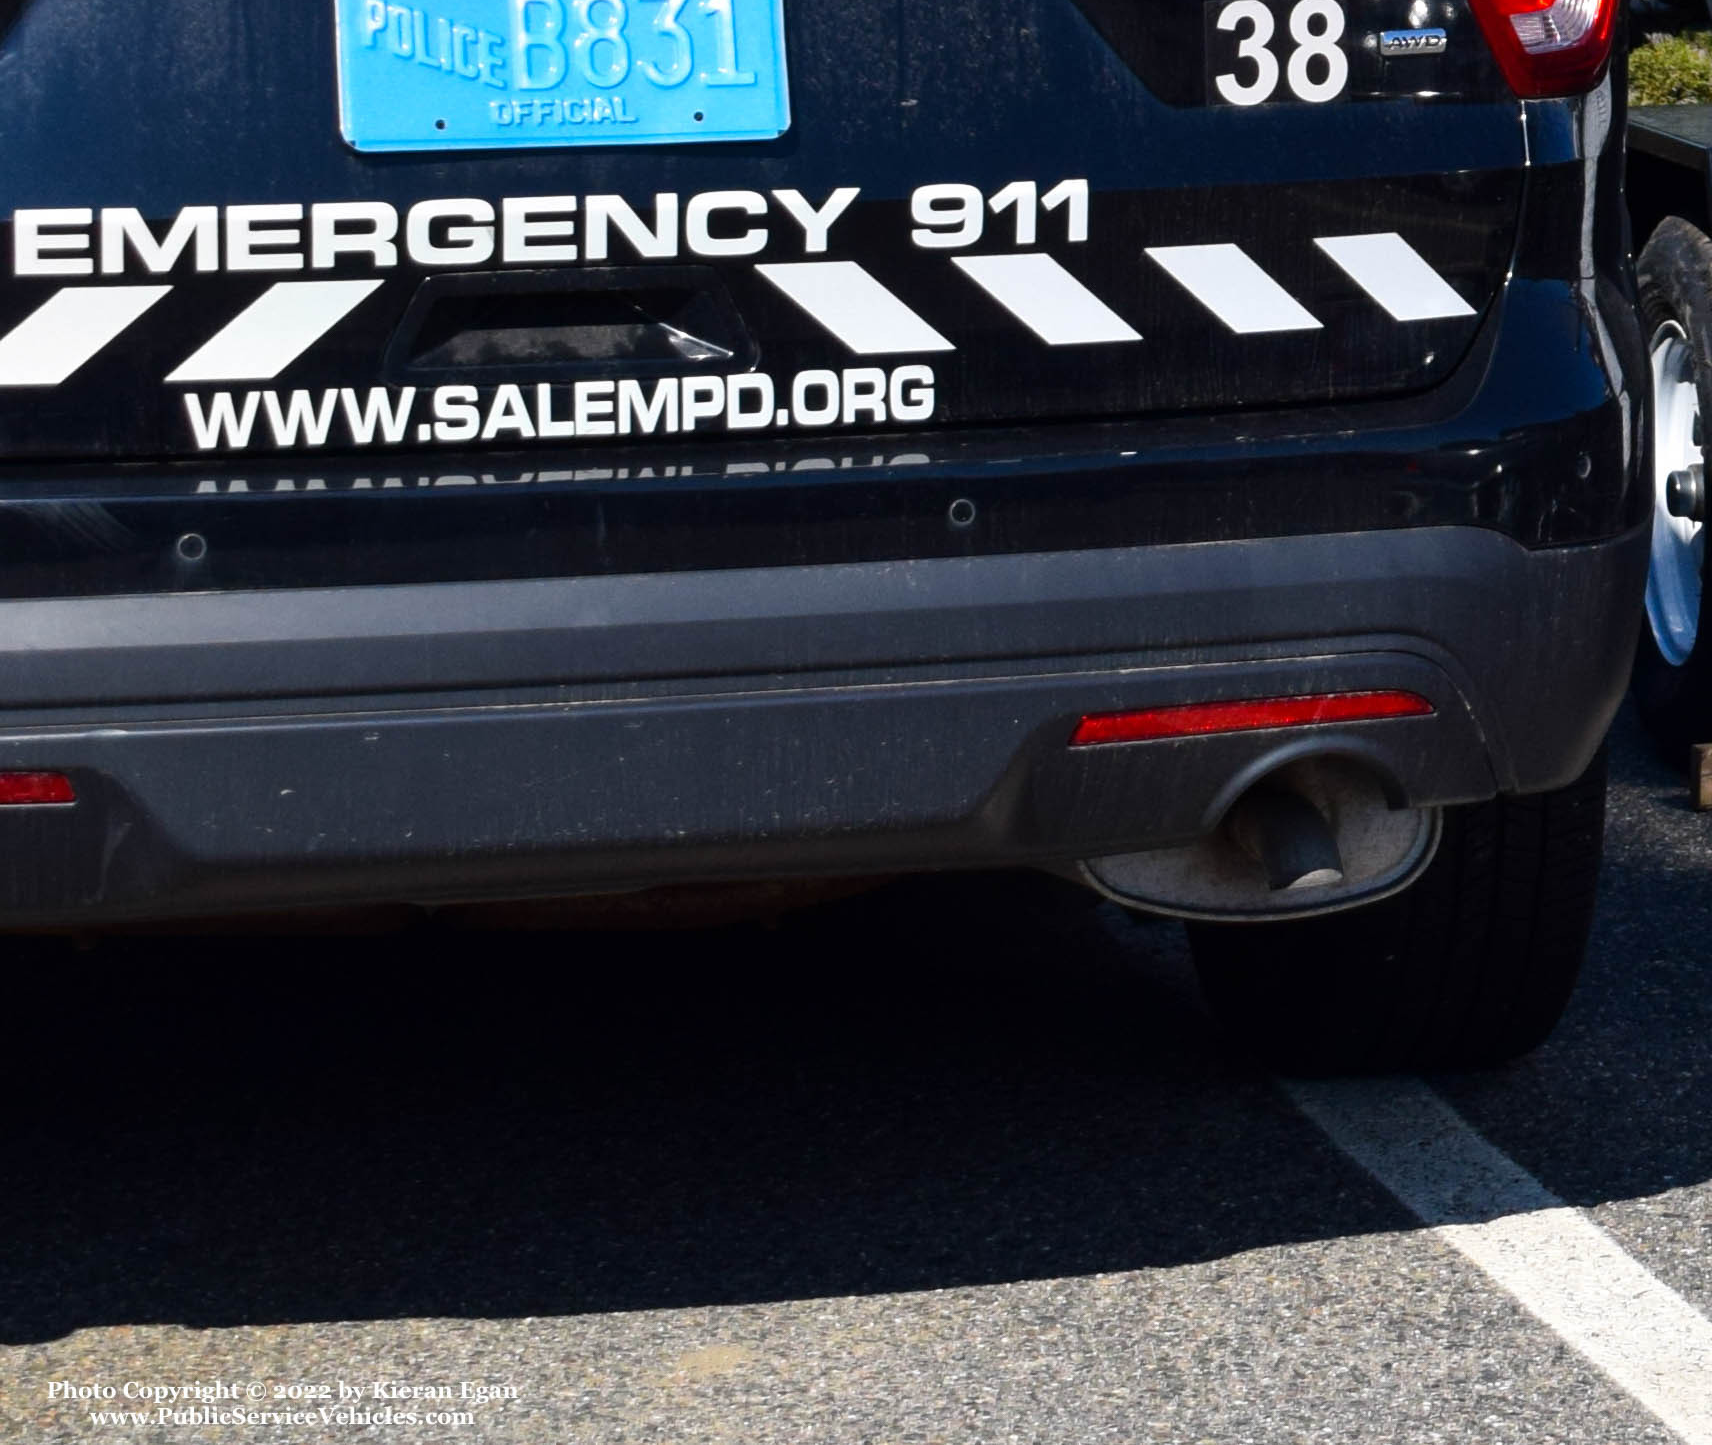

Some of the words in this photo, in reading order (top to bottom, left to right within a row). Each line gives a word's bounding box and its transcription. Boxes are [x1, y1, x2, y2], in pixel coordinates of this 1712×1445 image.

[1389, 34, 1443, 49] AWD
[488, 95, 638, 126] OFFICIAL
[13, 187, 861, 277] EMERGENCY
[911, 179, 1088, 248] 911
[184, 366, 935, 450] WWW.SALEMPD.ORG
